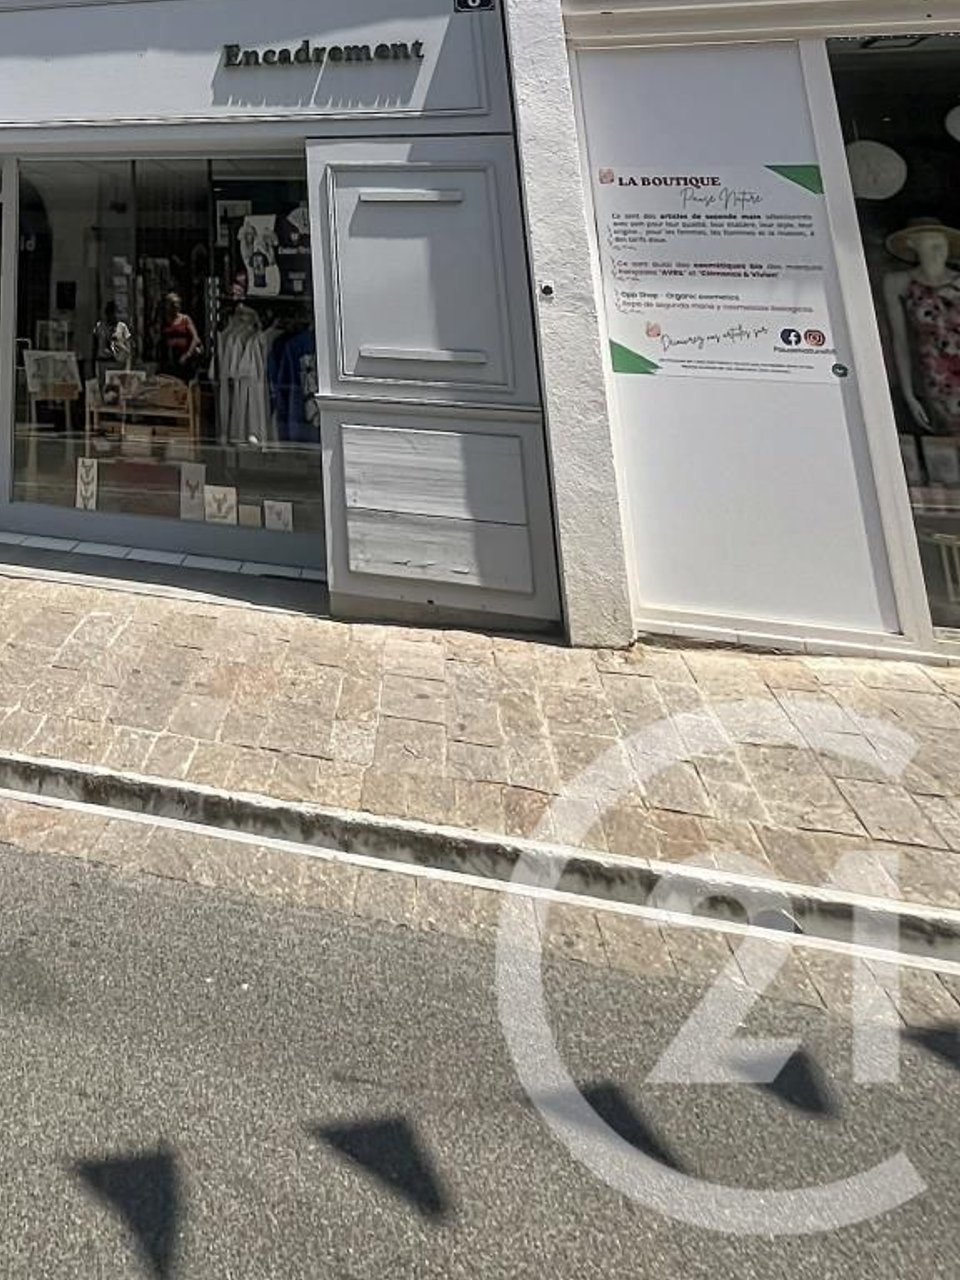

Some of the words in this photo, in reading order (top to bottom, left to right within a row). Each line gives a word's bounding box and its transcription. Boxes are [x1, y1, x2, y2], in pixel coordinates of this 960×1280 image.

[223, 39, 425, 67] Encadrement
[618, 177, 638, 186] LA
[641, 176, 721, 189] BOUTIQUE
